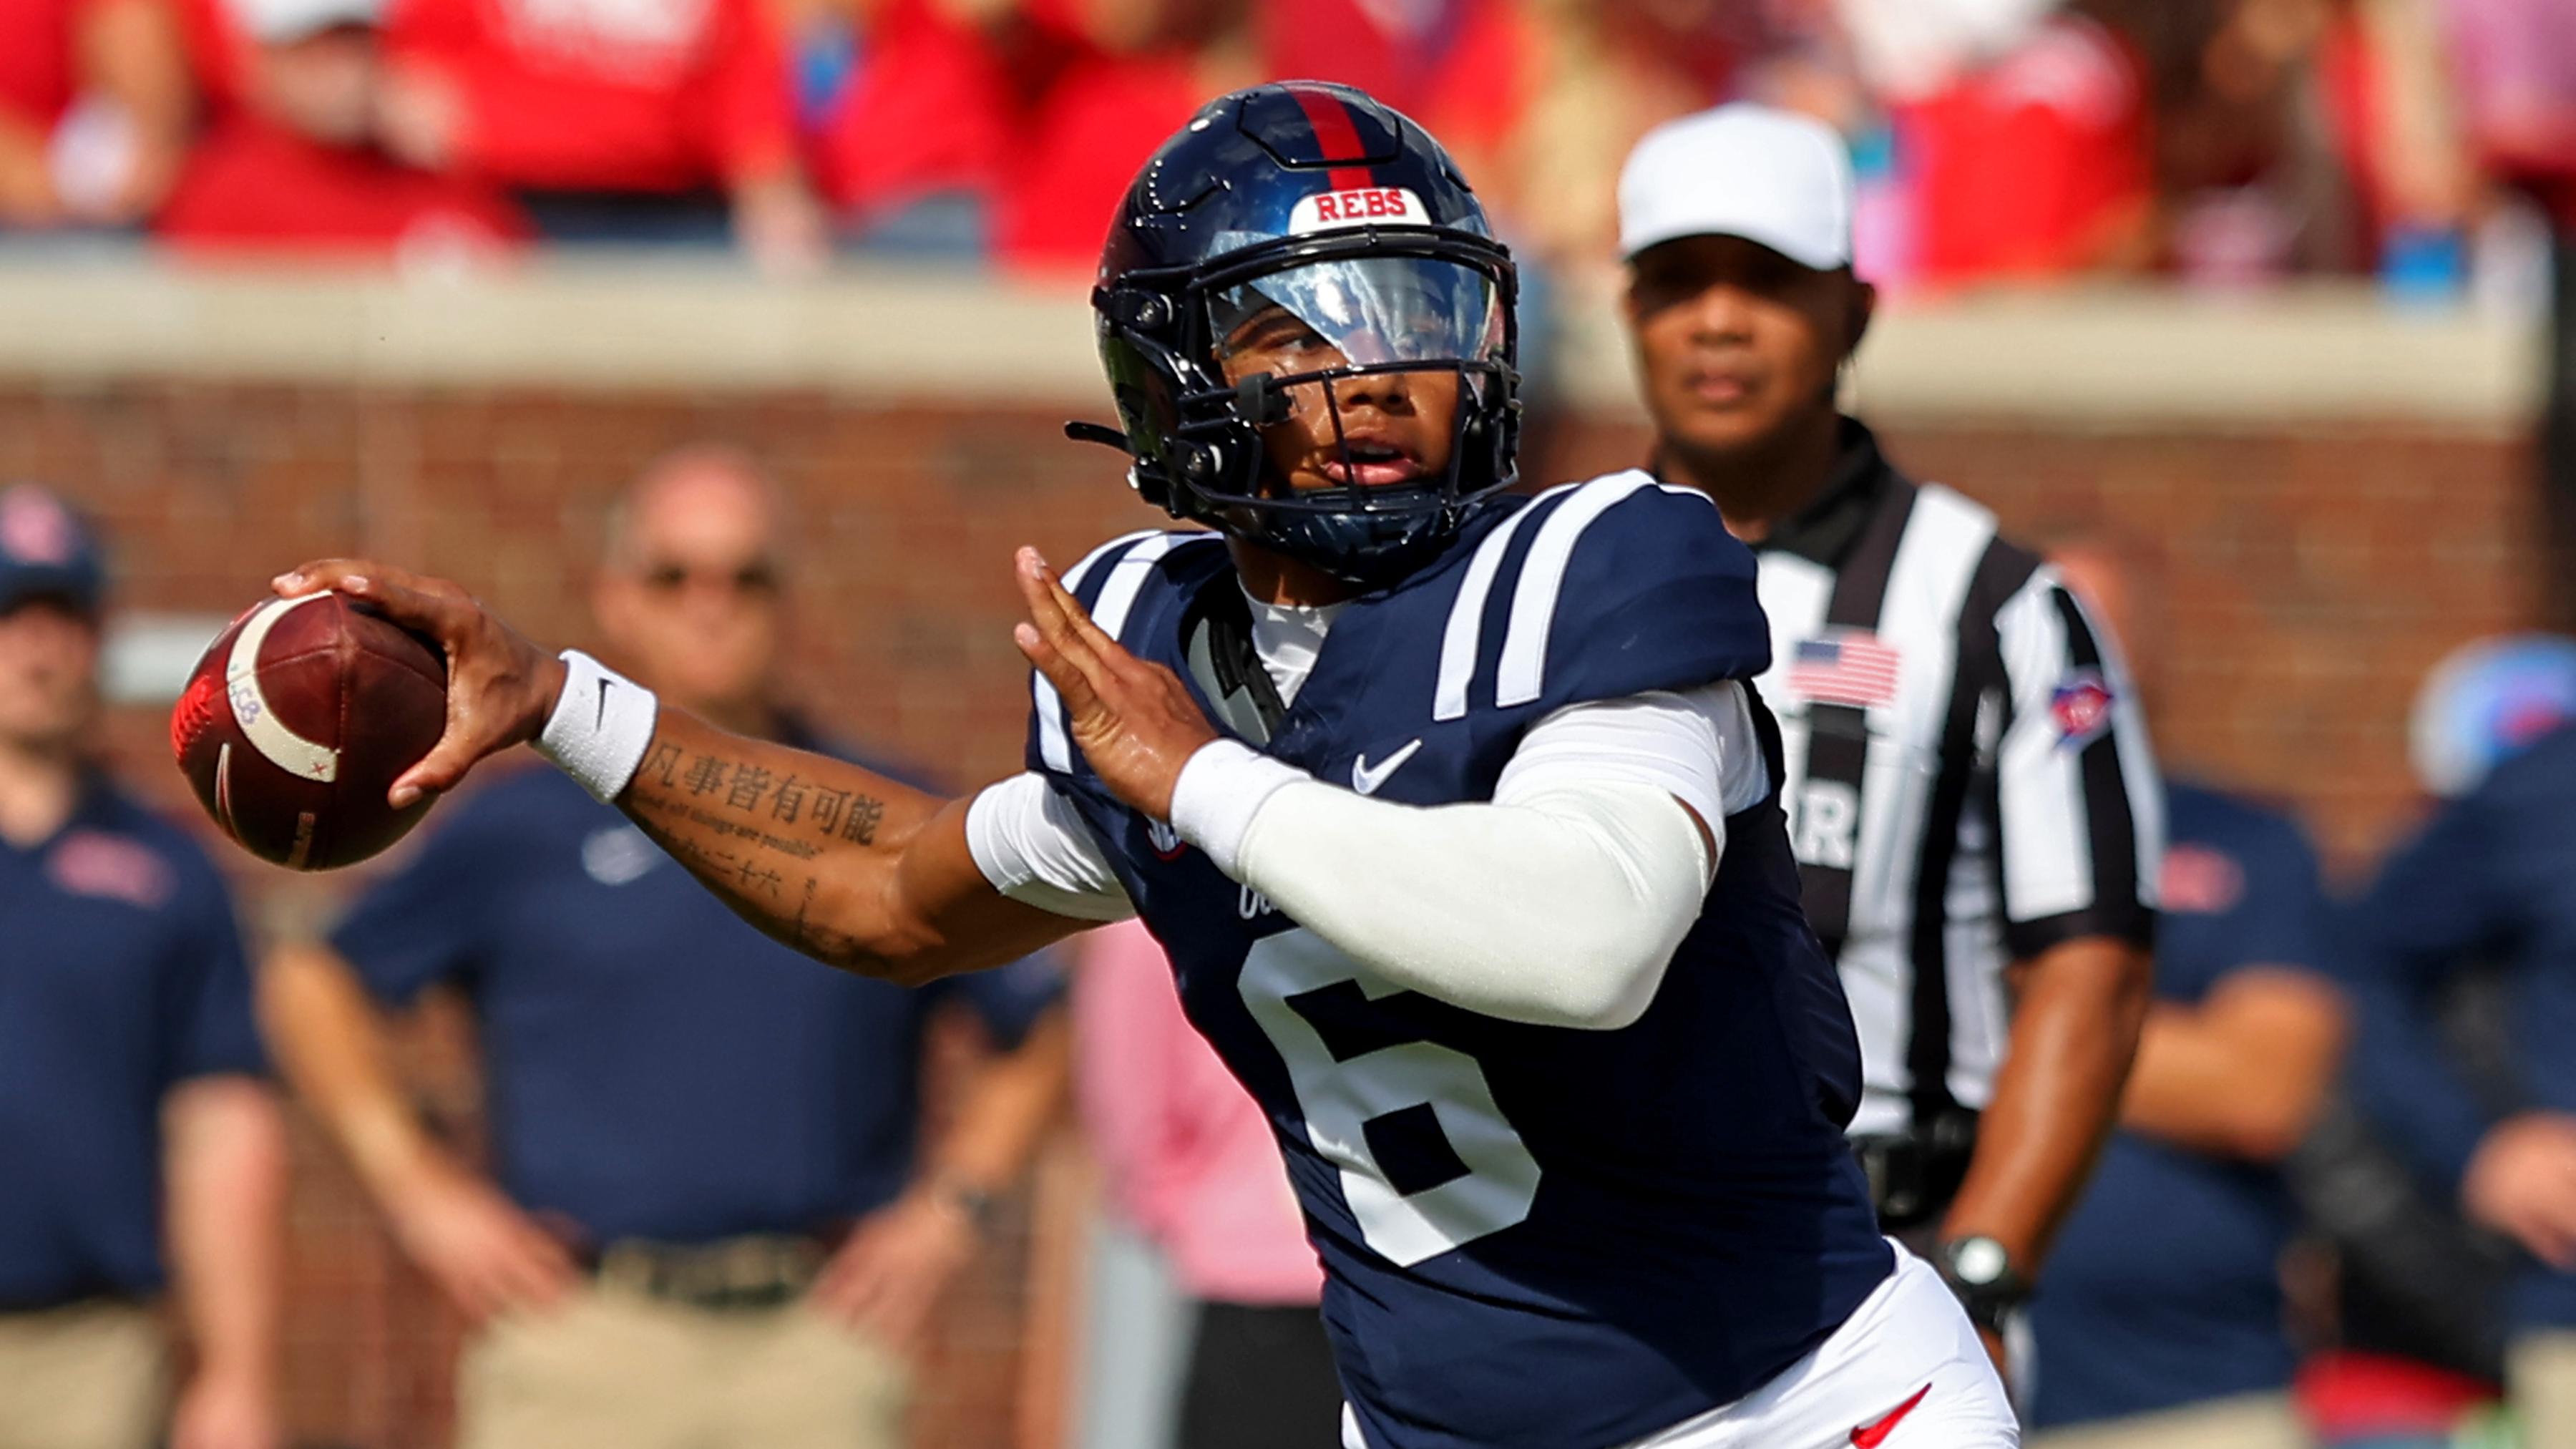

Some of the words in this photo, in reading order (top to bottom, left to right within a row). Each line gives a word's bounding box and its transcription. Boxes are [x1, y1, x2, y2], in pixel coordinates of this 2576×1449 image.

[1314, 188, 1407, 222] REBS
[645, 741, 885, 847] 凡事皆有可能
[1797, 779, 1856, 869] R
[1236, 927, 1542, 1268] 6
